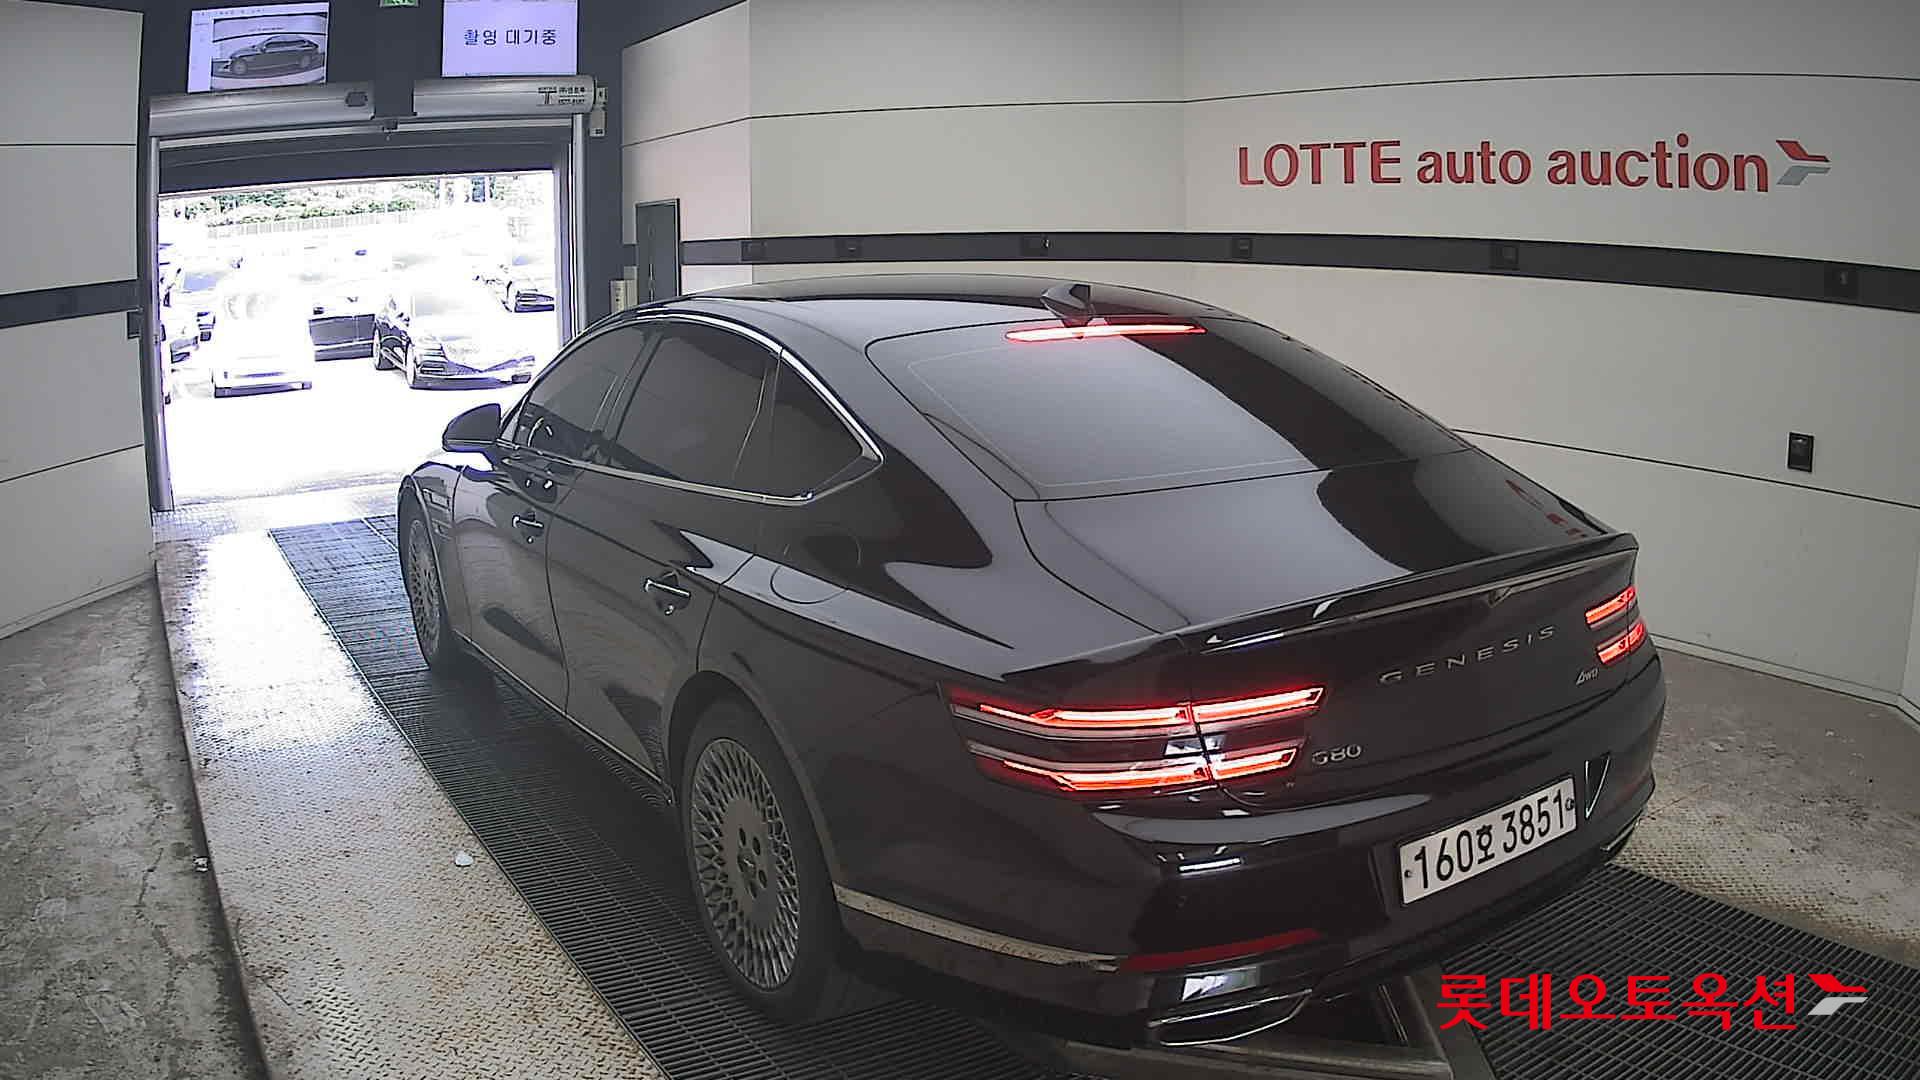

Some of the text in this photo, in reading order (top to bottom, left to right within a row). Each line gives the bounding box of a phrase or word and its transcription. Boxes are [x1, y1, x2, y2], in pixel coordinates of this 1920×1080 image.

[505, 29, 557, 46] 대기중
[1239, 133, 1769, 193] LOTTE auto auction
[1379, 625, 1555, 685] GENESIS
[1311, 744, 1362, 765] G80
[1501, 788, 1565, 854] 3851
